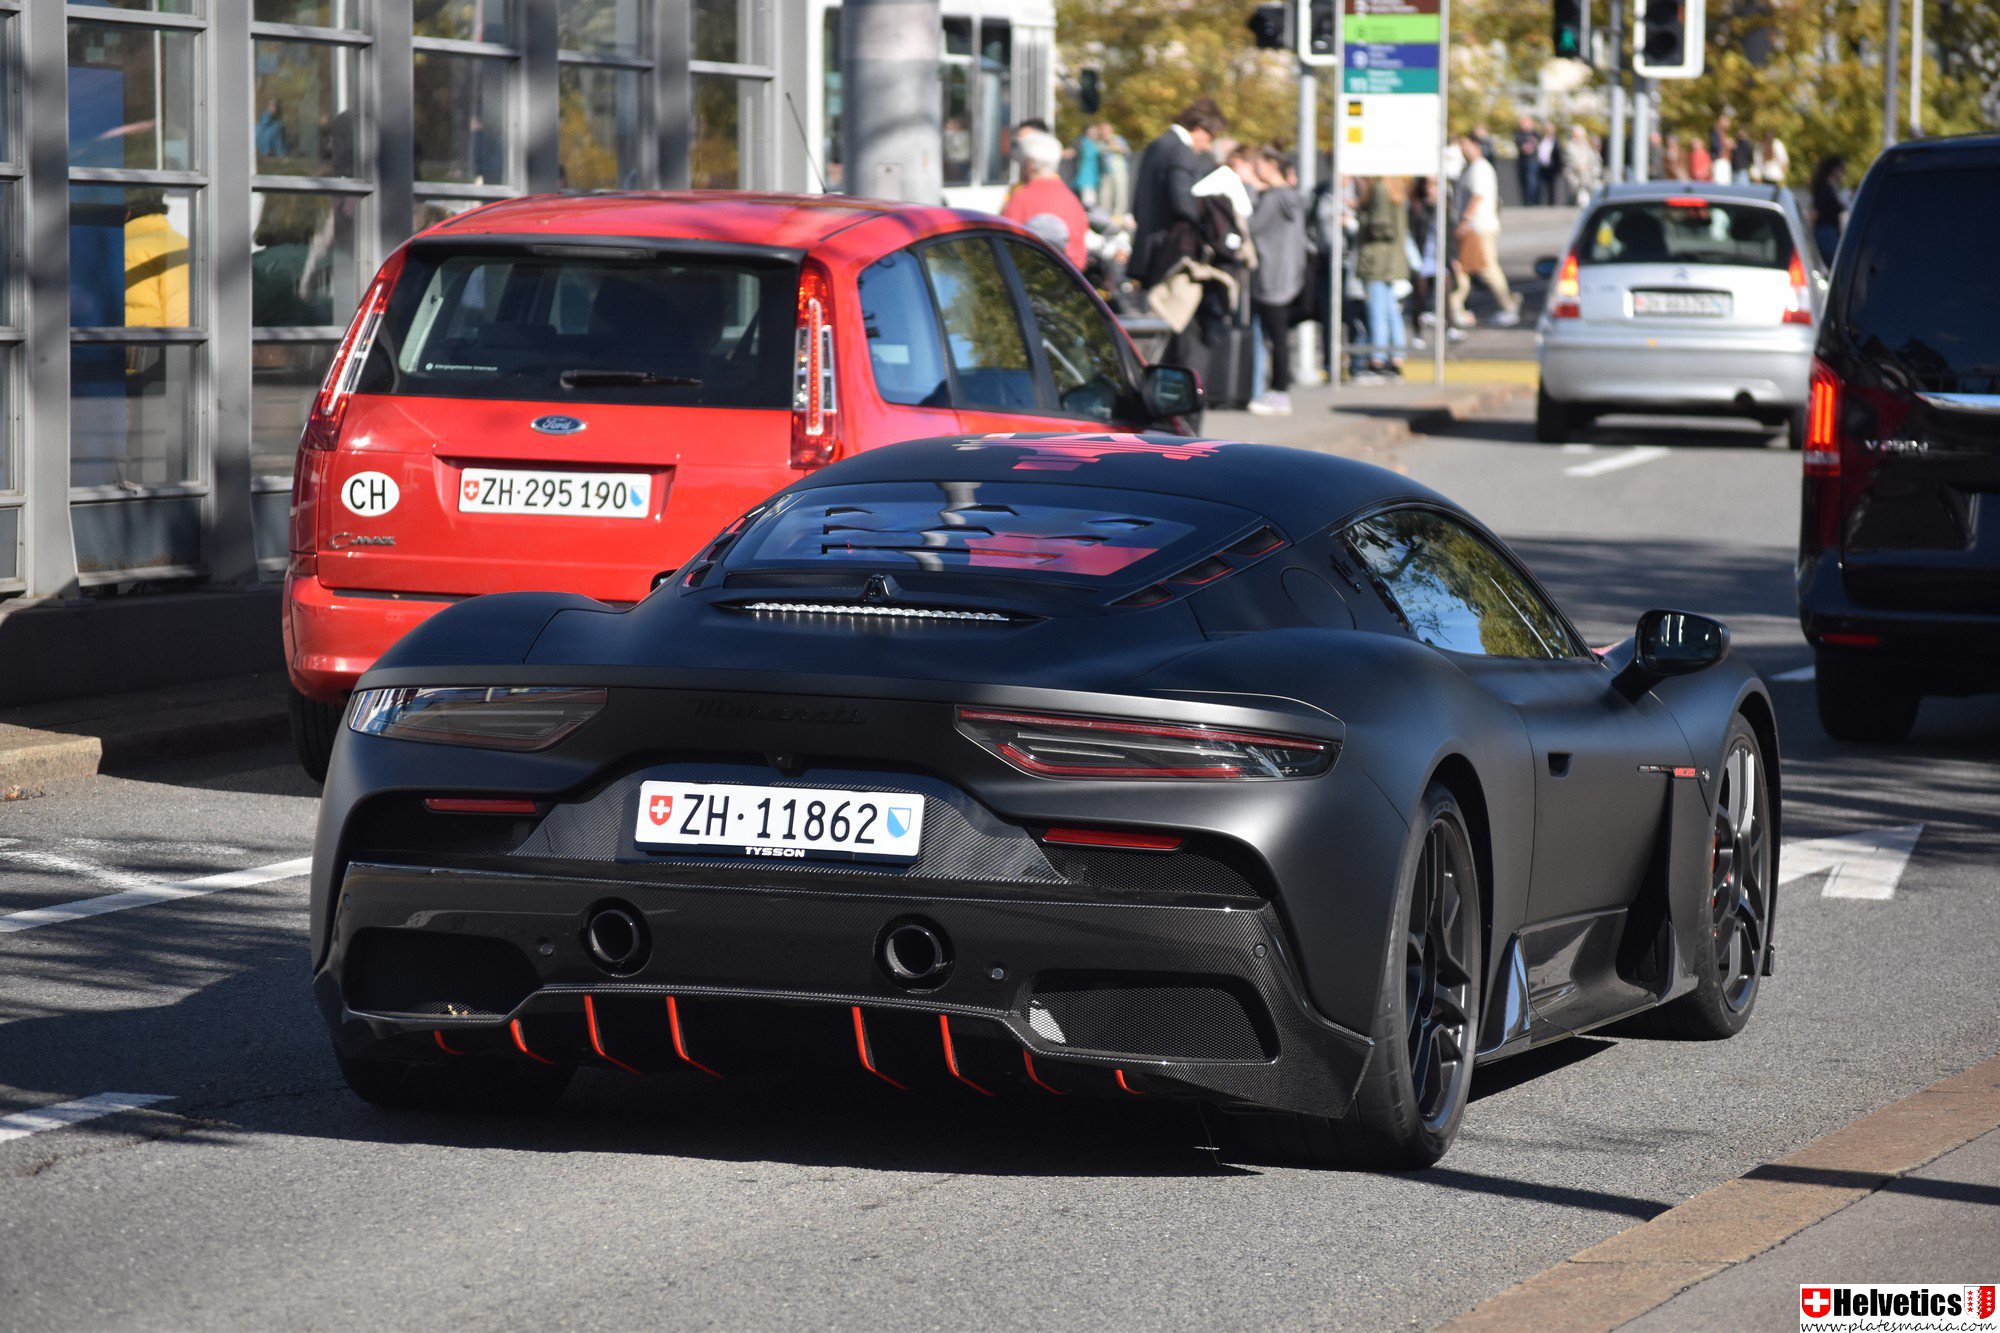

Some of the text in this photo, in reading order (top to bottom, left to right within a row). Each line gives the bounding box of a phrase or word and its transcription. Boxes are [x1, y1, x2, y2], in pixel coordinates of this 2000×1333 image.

[541, 419, 571, 431] Ford
[350, 478, 386, 510] CH
[687, 698, 872, 727] Maserati
[745, 846, 806, 858] TYSSON
